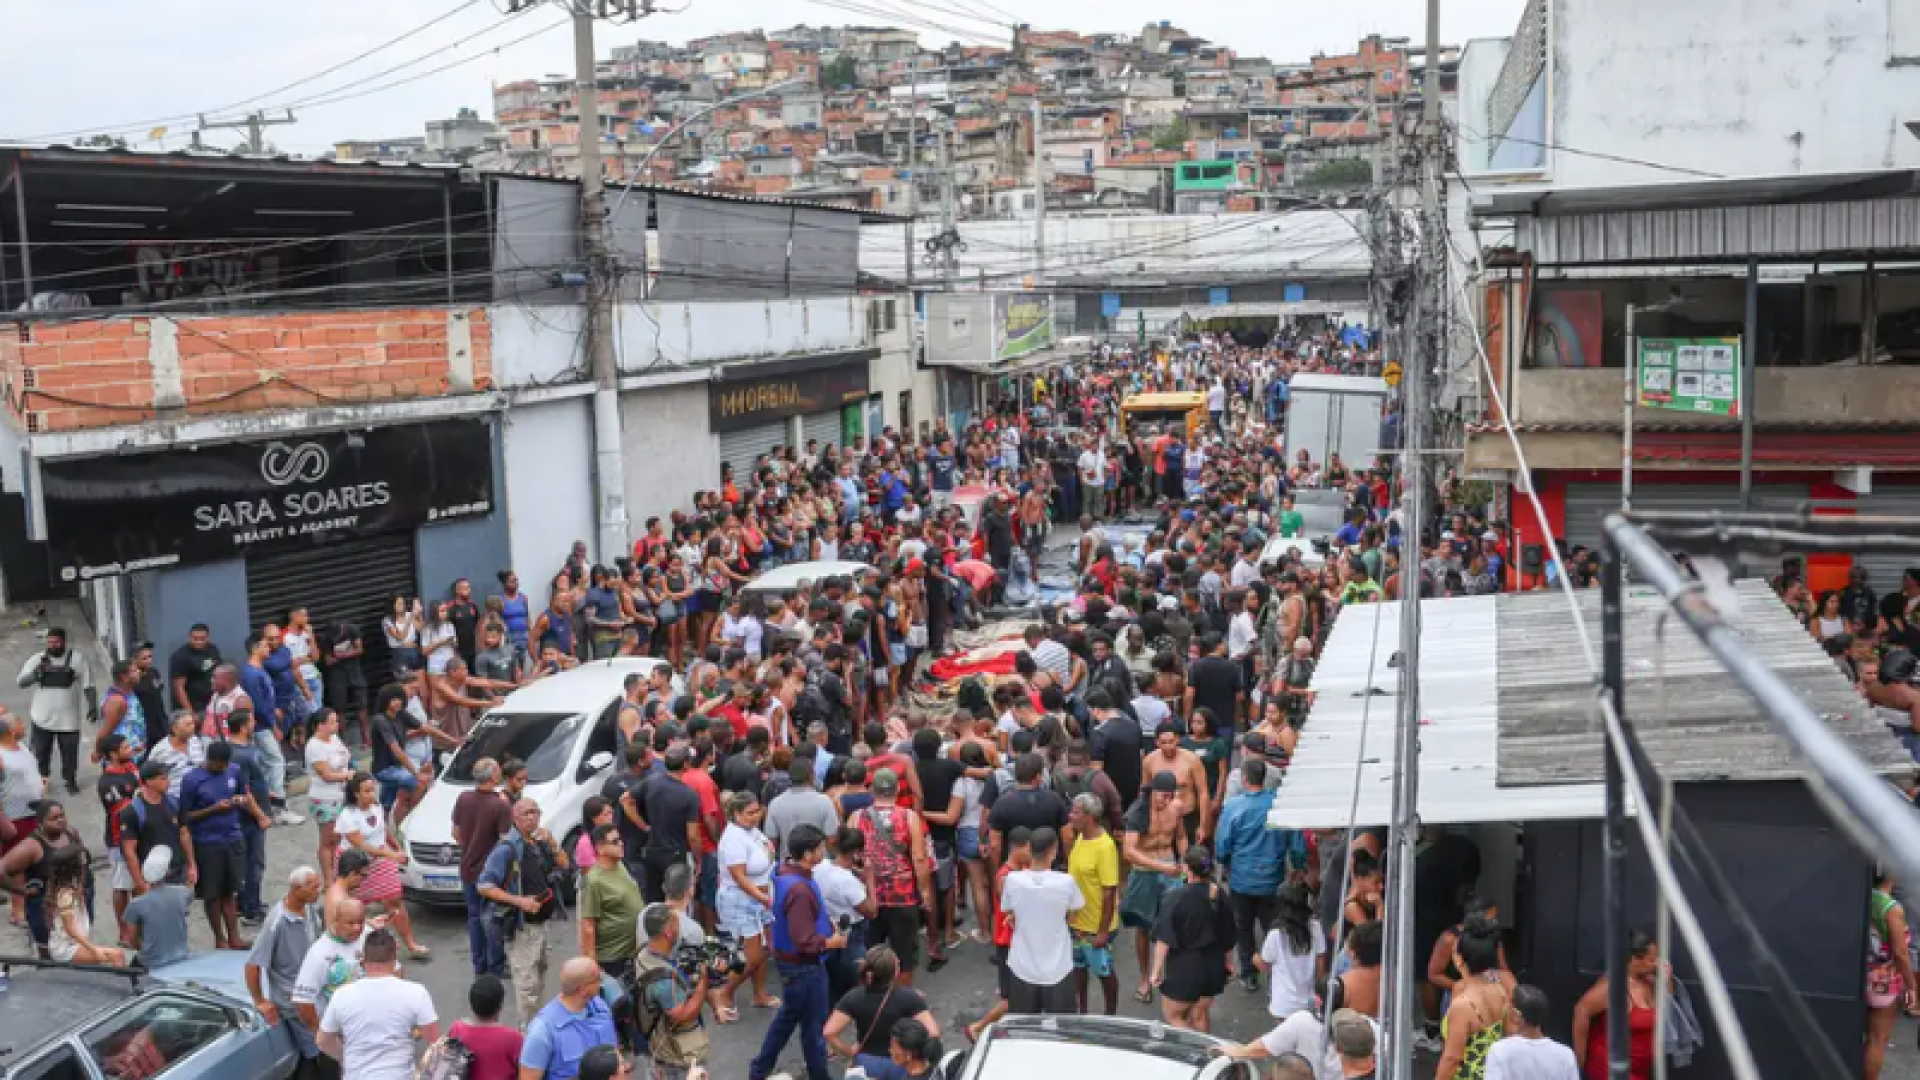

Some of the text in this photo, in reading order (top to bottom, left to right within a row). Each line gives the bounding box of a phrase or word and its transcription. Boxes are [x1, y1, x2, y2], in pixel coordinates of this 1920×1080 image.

[194, 498, 276, 531] SARA
[283, 481, 390, 517] SOARES
[233, 527, 284, 545] BEAUTY
[300, 515, 359, 534] ACADEMY
